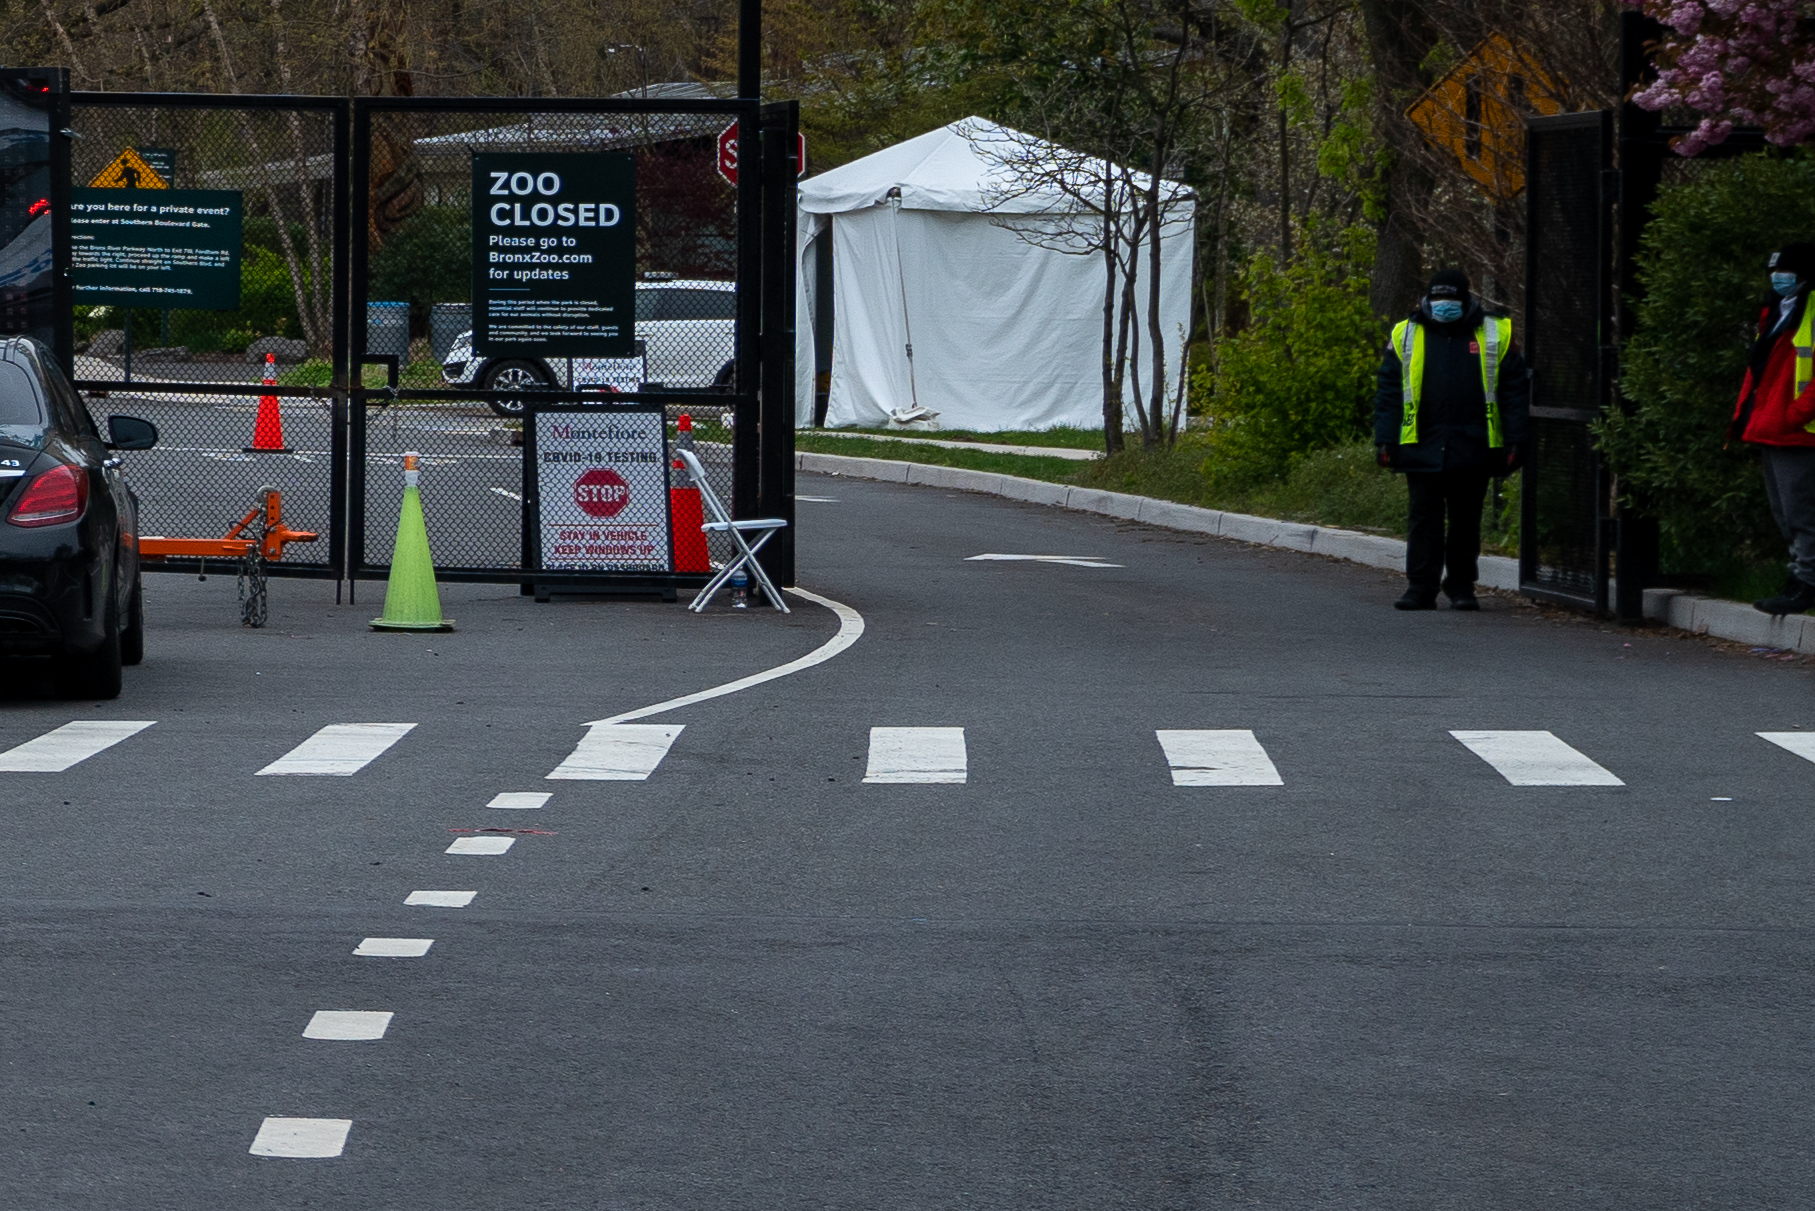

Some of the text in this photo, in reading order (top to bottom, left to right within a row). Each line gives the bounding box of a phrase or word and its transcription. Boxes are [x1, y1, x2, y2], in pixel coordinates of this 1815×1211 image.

[490, 172, 560, 195] ZOO
[86, 205, 104, 214] you
[108, 204, 130, 212] here
[134, 204, 148, 213] for
[160, 206, 194, 216] private
[197, 207, 230, 215] event?
[490, 203, 620, 226] CLOSED
[489, 236, 576, 249] Please go to
[489, 252, 593, 263] BronxZoo.com
[489, 268, 569, 282] for updates
[552, 424, 646, 440] Montefiore
[544, 452, 658, 463] COVID-19 TESTING
[577, 485, 625, 502] STOP
[560, 531, 585, 541] STAY
[554, 545, 582, 555] KEEP
